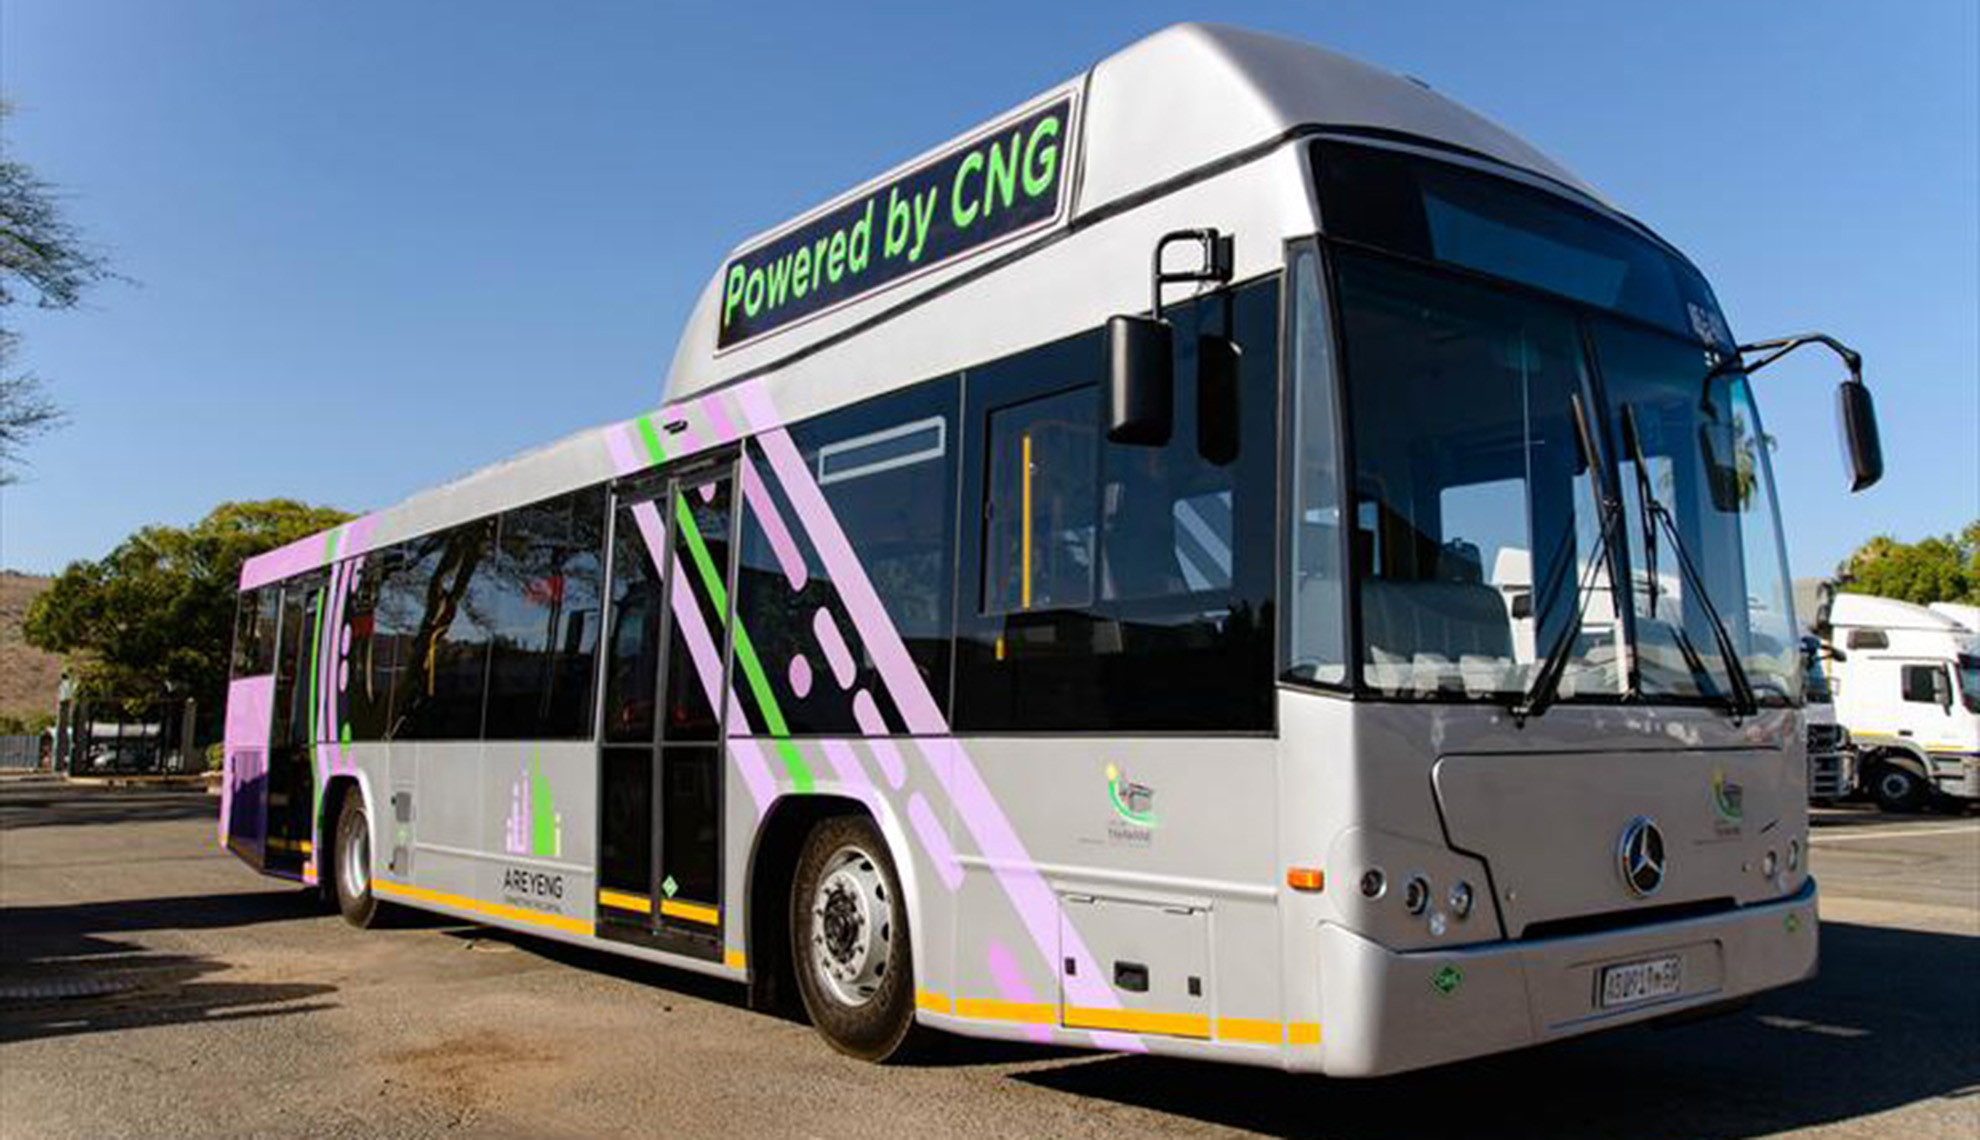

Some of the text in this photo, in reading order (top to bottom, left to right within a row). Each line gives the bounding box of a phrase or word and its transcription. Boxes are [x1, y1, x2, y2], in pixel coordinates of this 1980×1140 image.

[723, 115, 1060, 326] Powered by CNG
[503, 868, 563, 899] AREYENG
